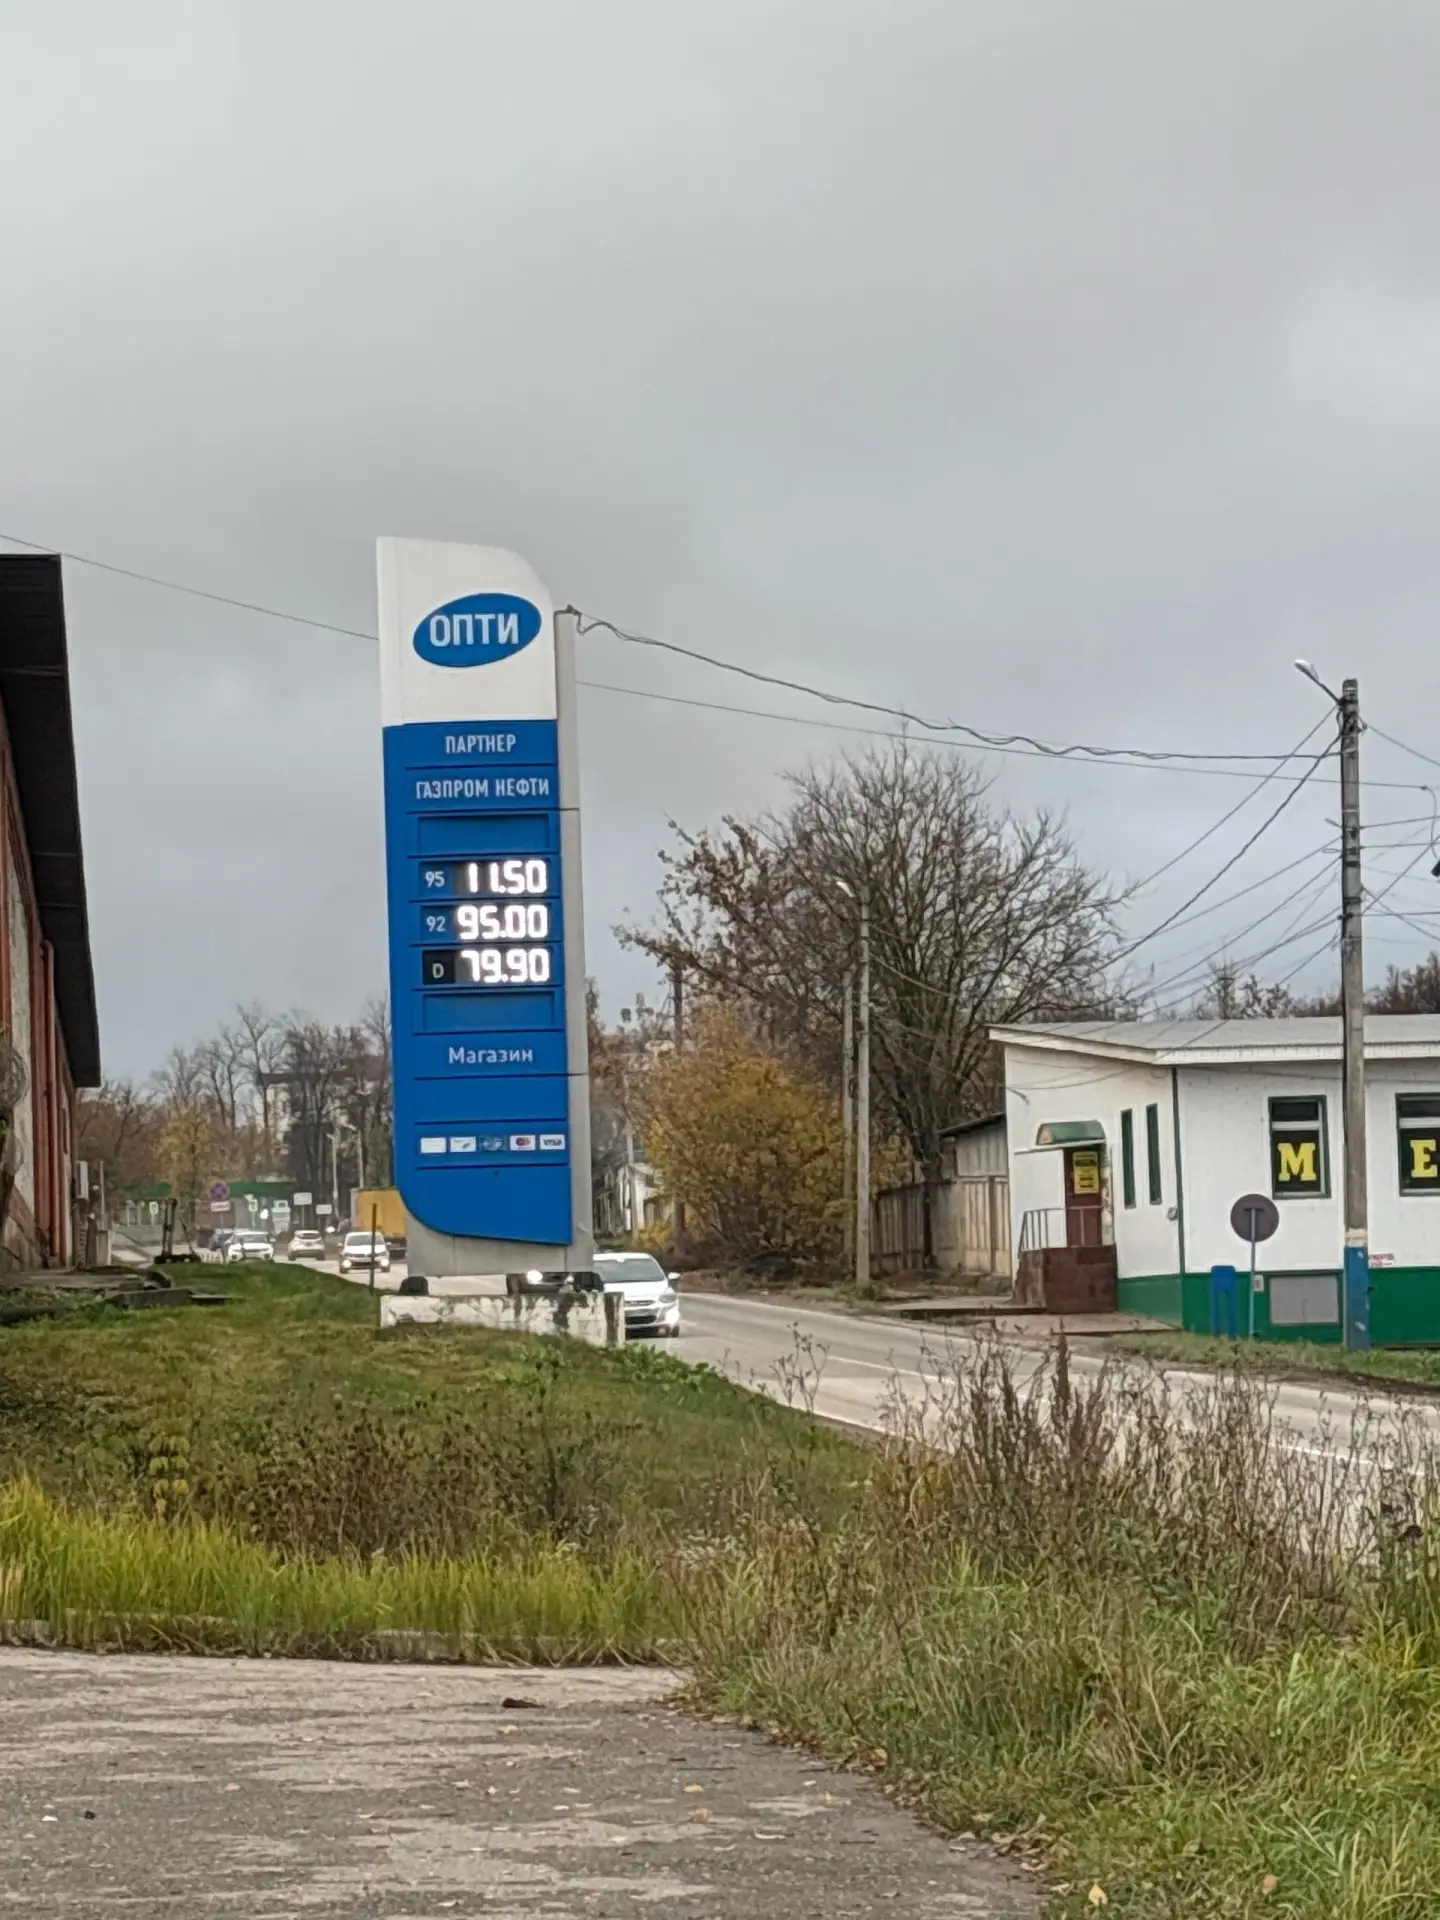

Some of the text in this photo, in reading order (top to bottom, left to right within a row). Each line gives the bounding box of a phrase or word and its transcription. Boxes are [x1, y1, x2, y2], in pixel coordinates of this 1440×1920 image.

[429, 613, 520, 648] ОПТИ
[445, 734, 517, 754] ПАРТНЕР
[415, 778, 550, 800] ГАЗПРОМ НЕФТИ
[425, 859, 548, 895] 95 11.50
[426, 904, 549, 941] 92 95.00
[432, 948, 550, 984] D 79.90
[448, 1045, 533, 1065] Магазин
